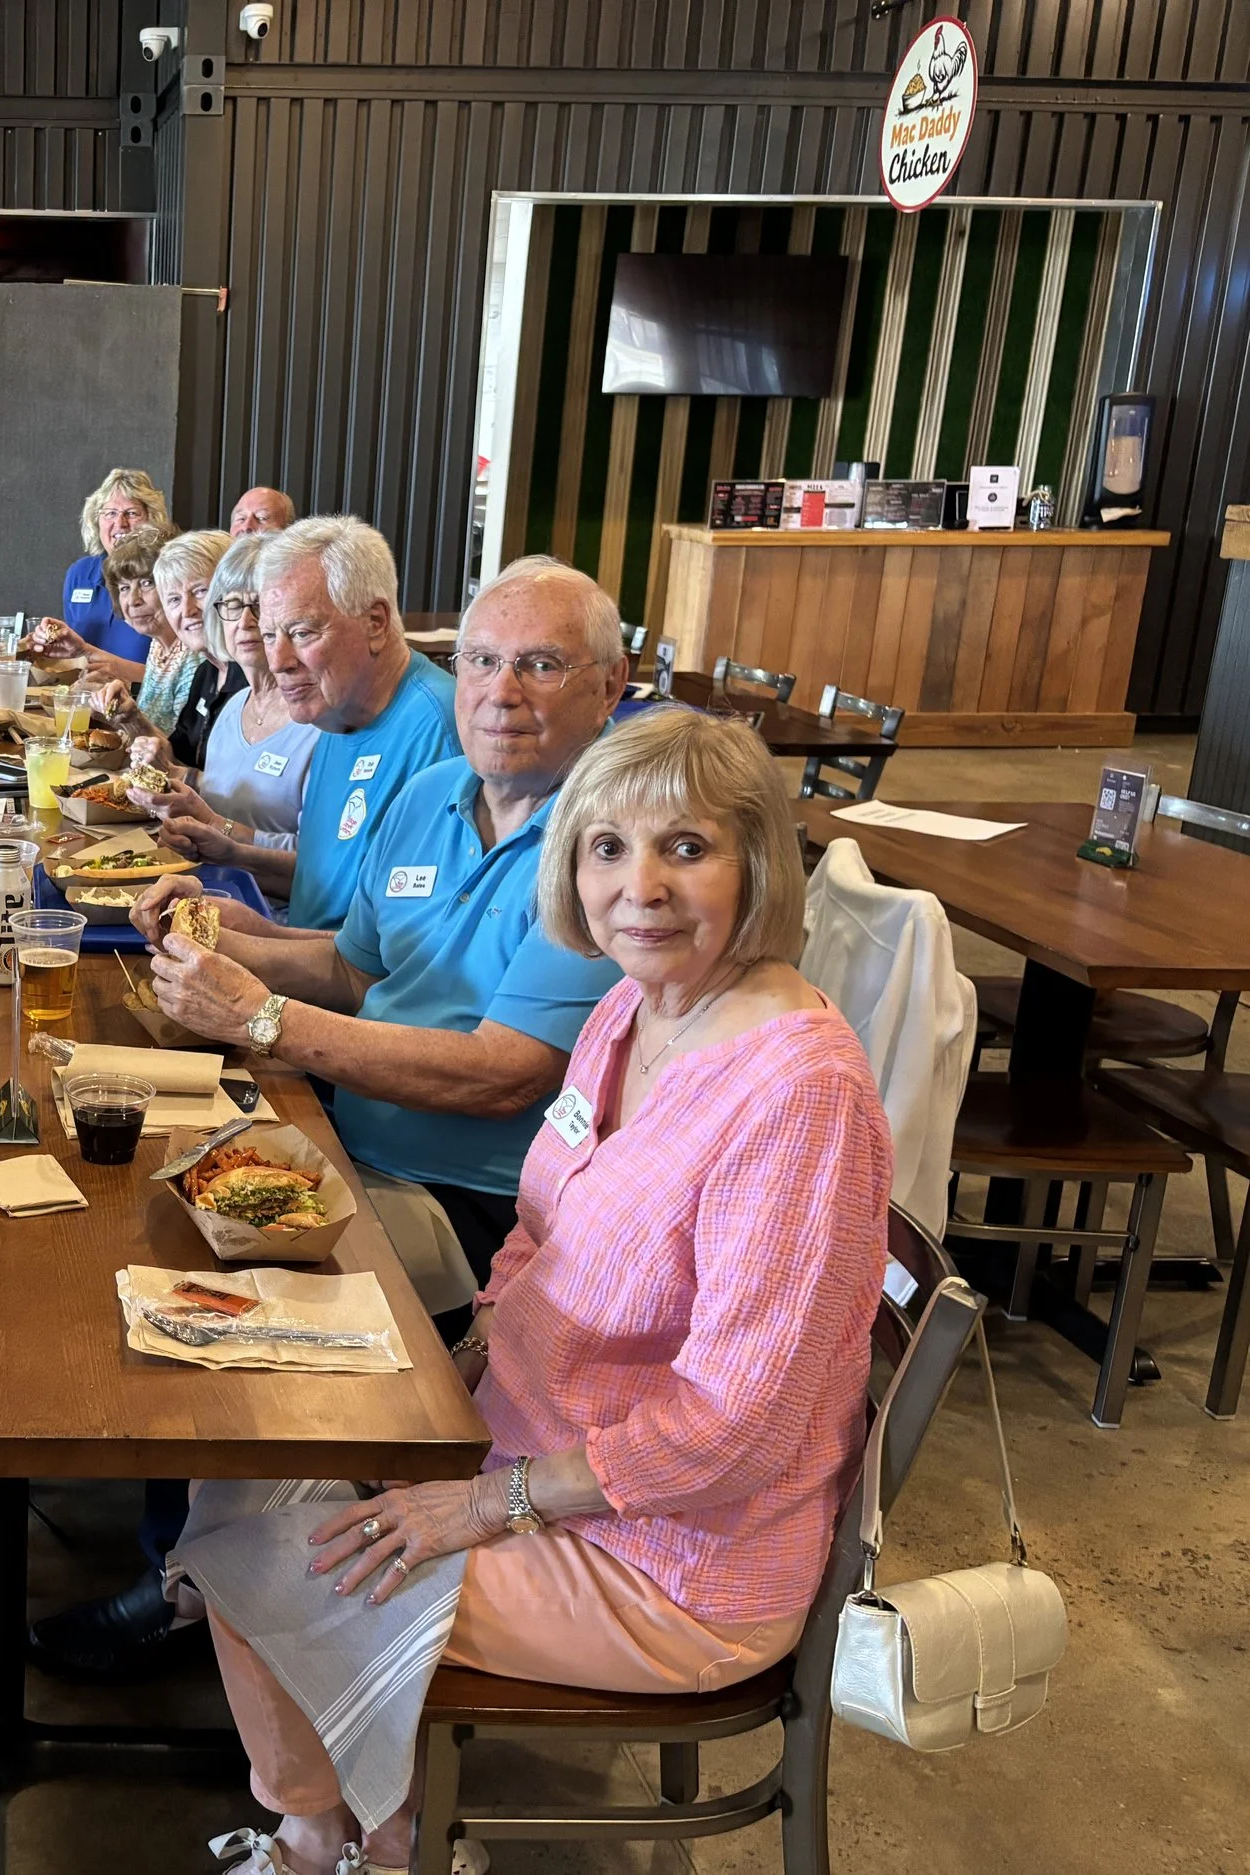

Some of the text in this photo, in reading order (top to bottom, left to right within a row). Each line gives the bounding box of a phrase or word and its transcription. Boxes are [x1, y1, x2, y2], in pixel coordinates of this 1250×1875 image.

[890, 107, 962, 149] Mac Daddy
[888, 143, 951, 185] Chicken
[573, 1109, 590, 1130] Bonnie
